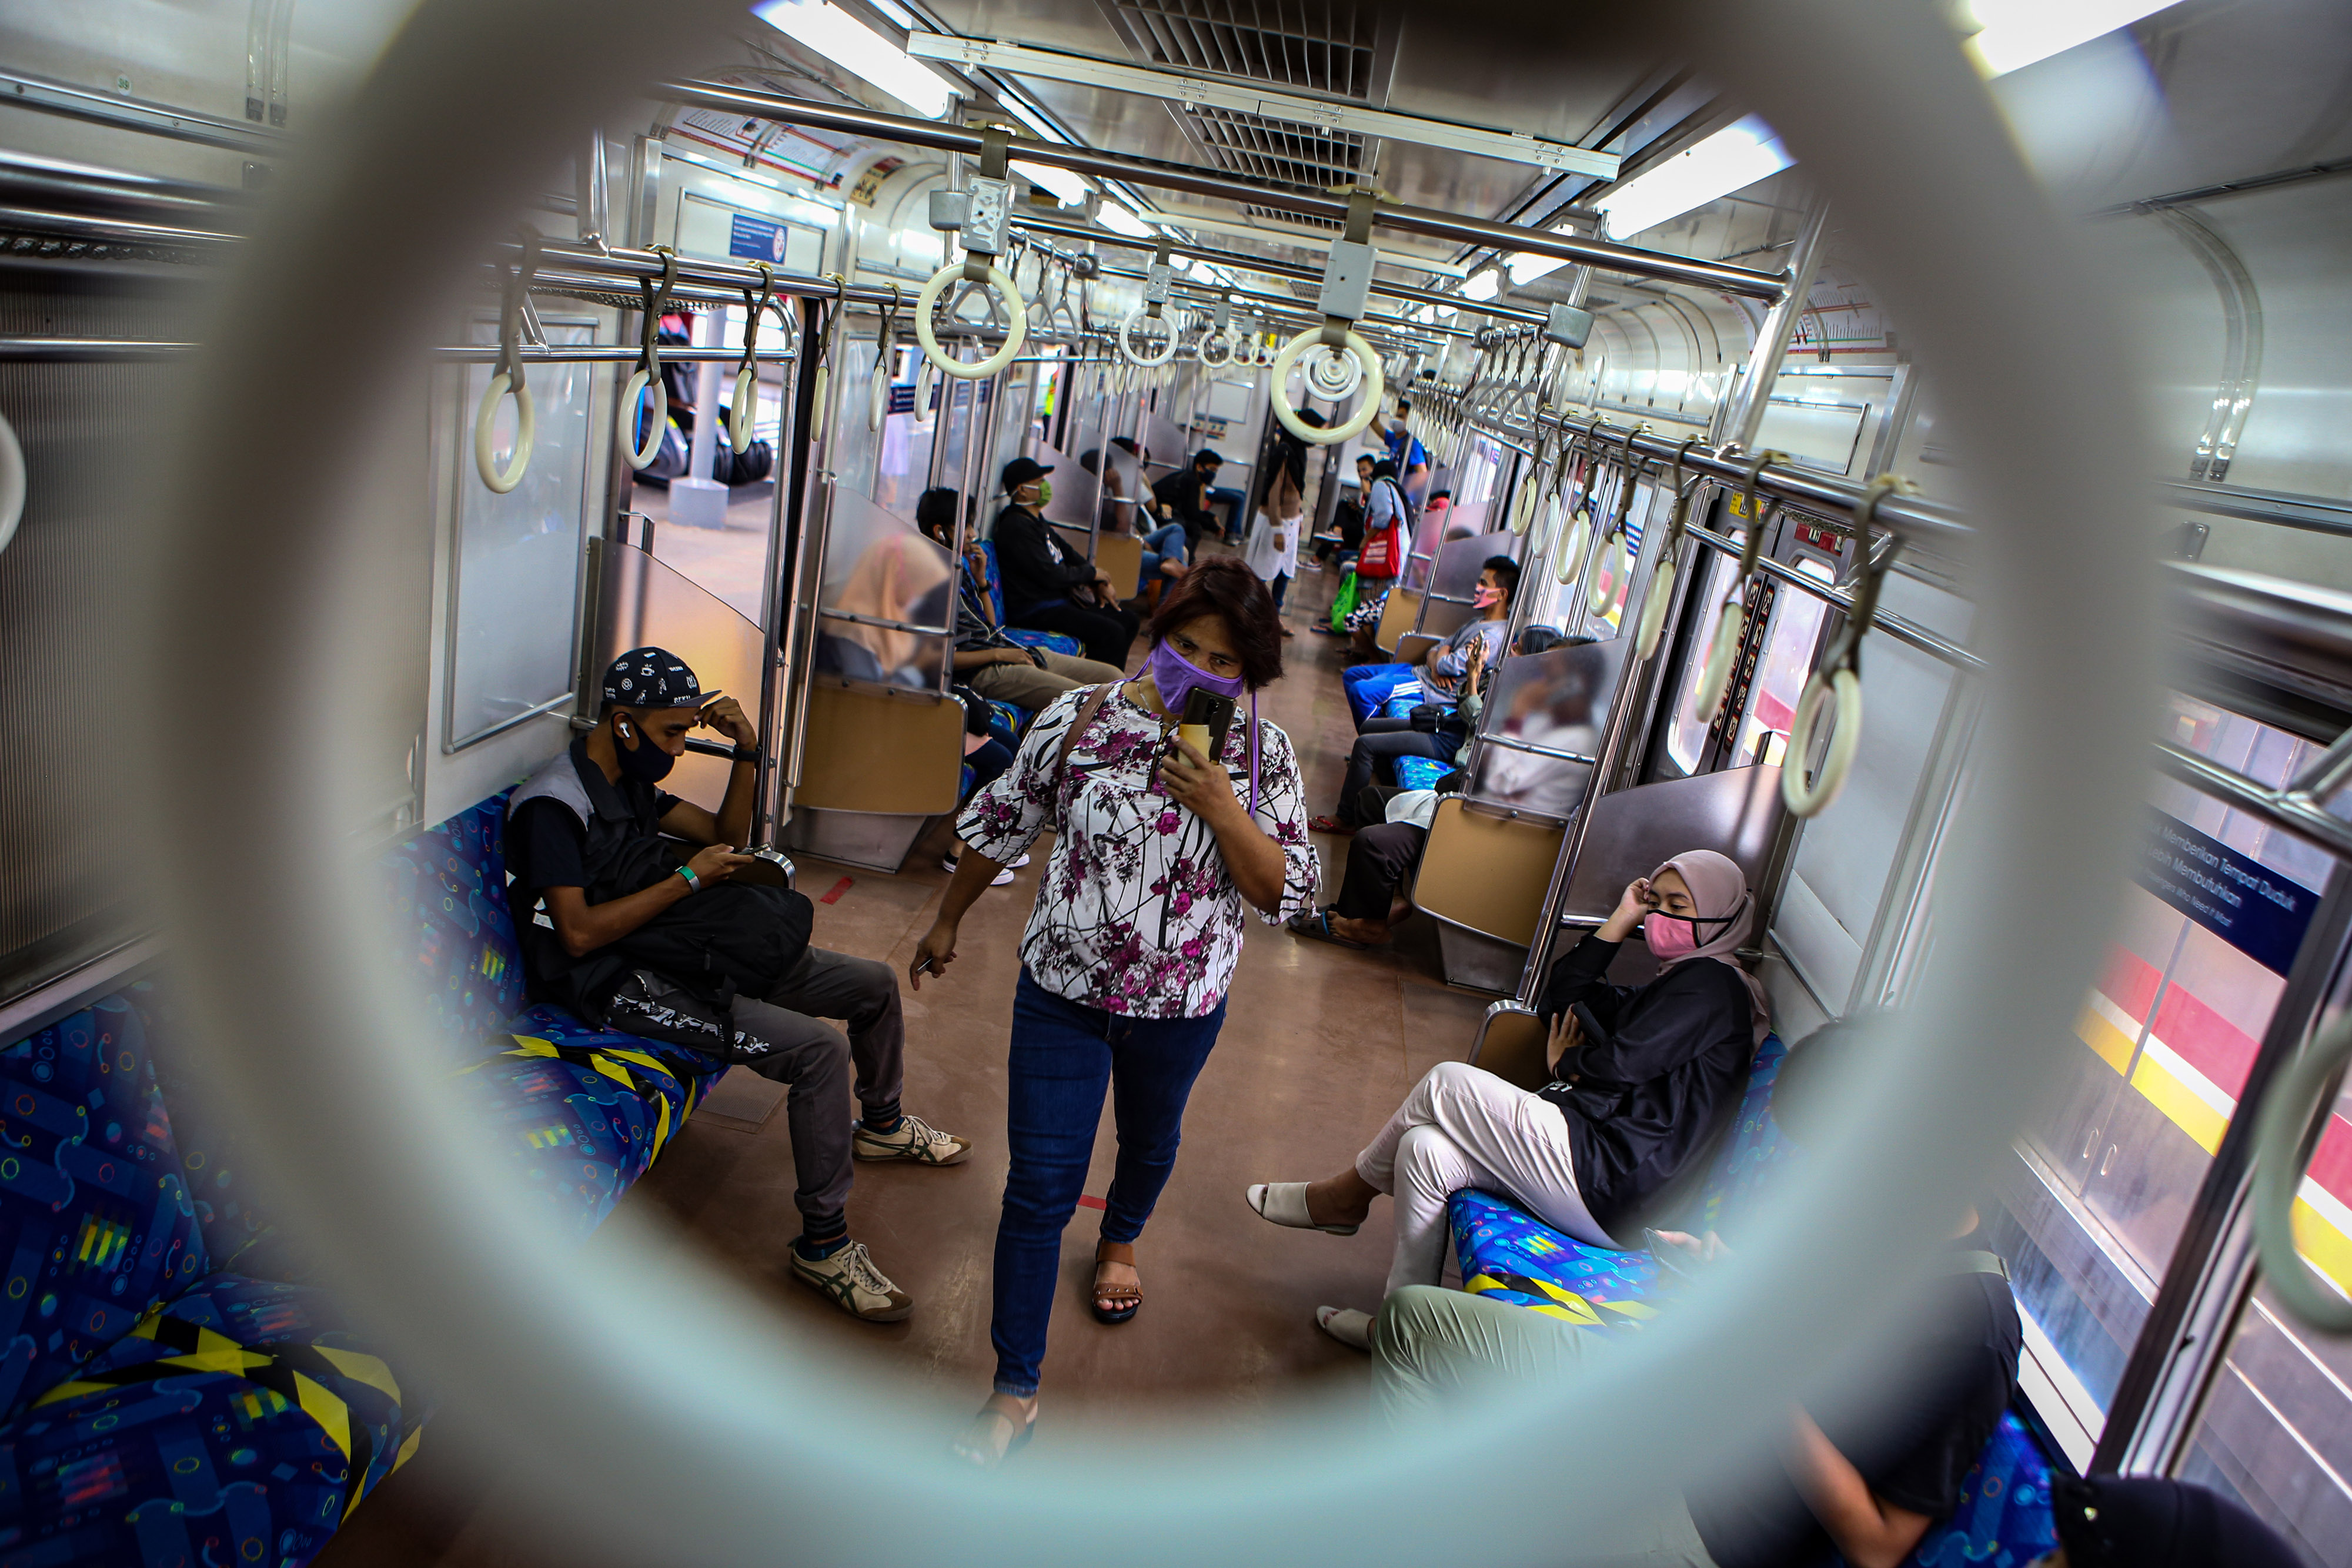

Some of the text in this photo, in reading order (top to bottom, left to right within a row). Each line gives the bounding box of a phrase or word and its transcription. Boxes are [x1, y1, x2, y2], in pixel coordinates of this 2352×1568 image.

[2161, 826, 2219, 868] Memberikan
[2219, 857, 2260, 890] Tempat
[2258, 880, 2296, 912] Duduk
[2172, 857, 2241, 908] Membutuhkan
